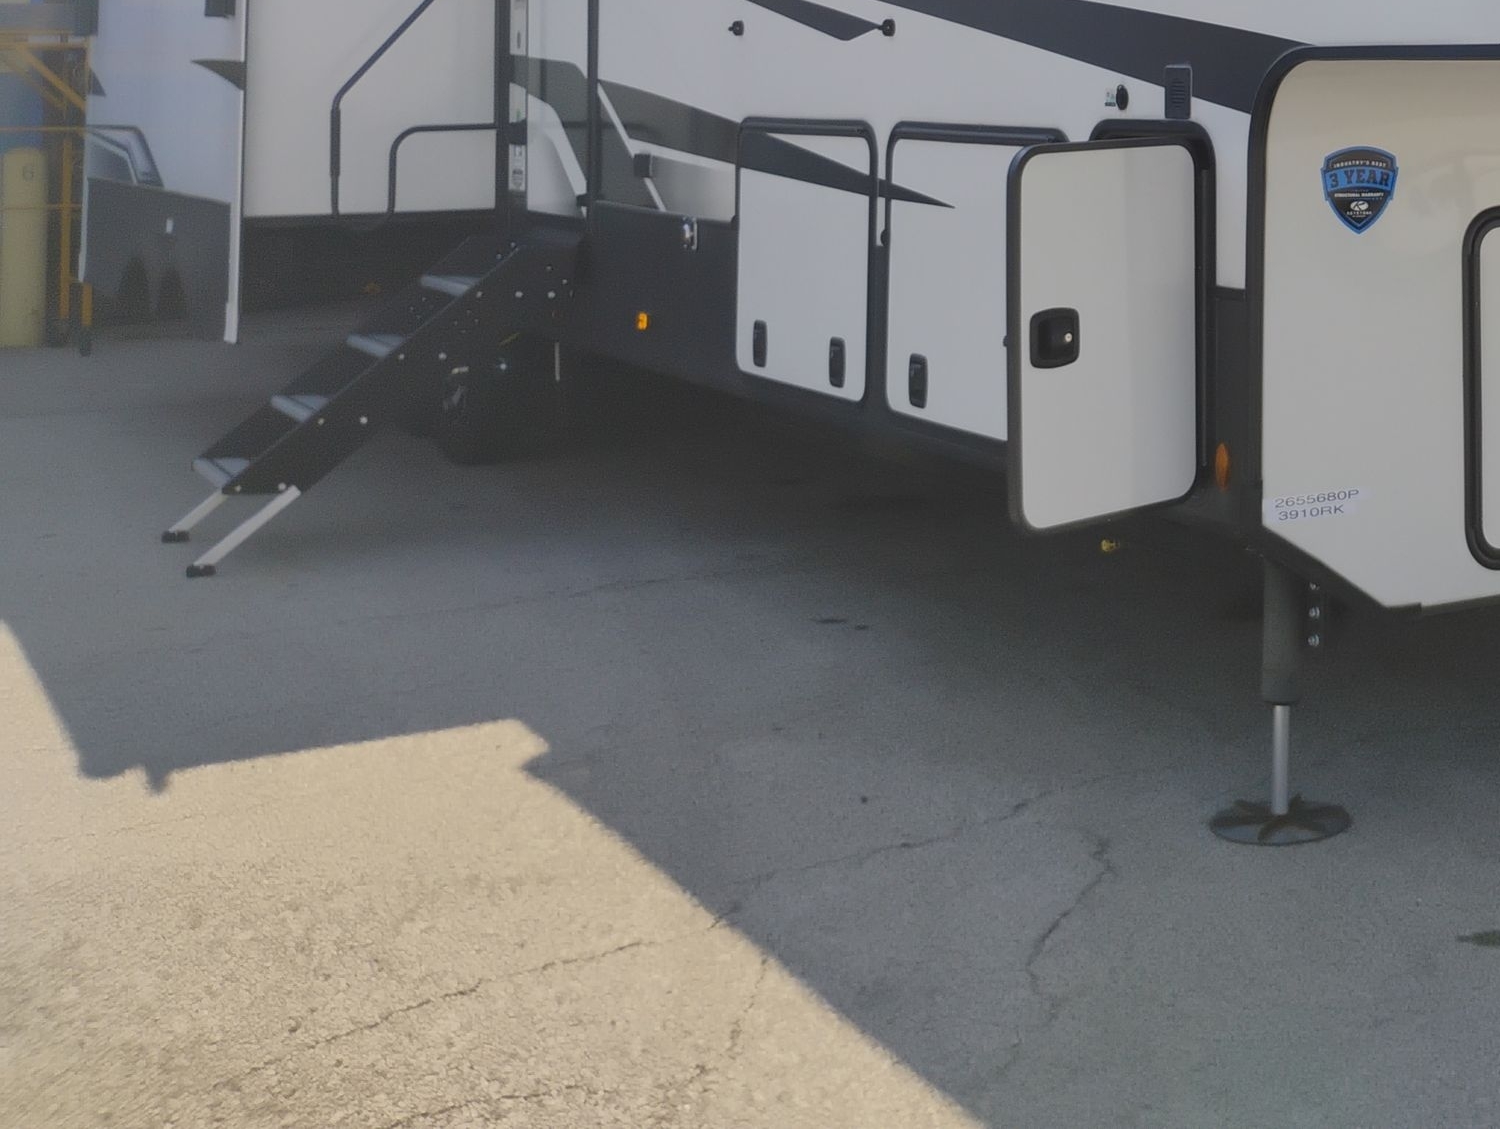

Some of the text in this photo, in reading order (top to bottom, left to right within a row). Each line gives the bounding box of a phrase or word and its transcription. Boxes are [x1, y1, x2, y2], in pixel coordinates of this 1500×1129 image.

[1329, 168, 1390, 188] 3 YEAR
[1274, 489, 1360, 509] 2655680P
[1278, 504, 1345, 521] 3910RK
